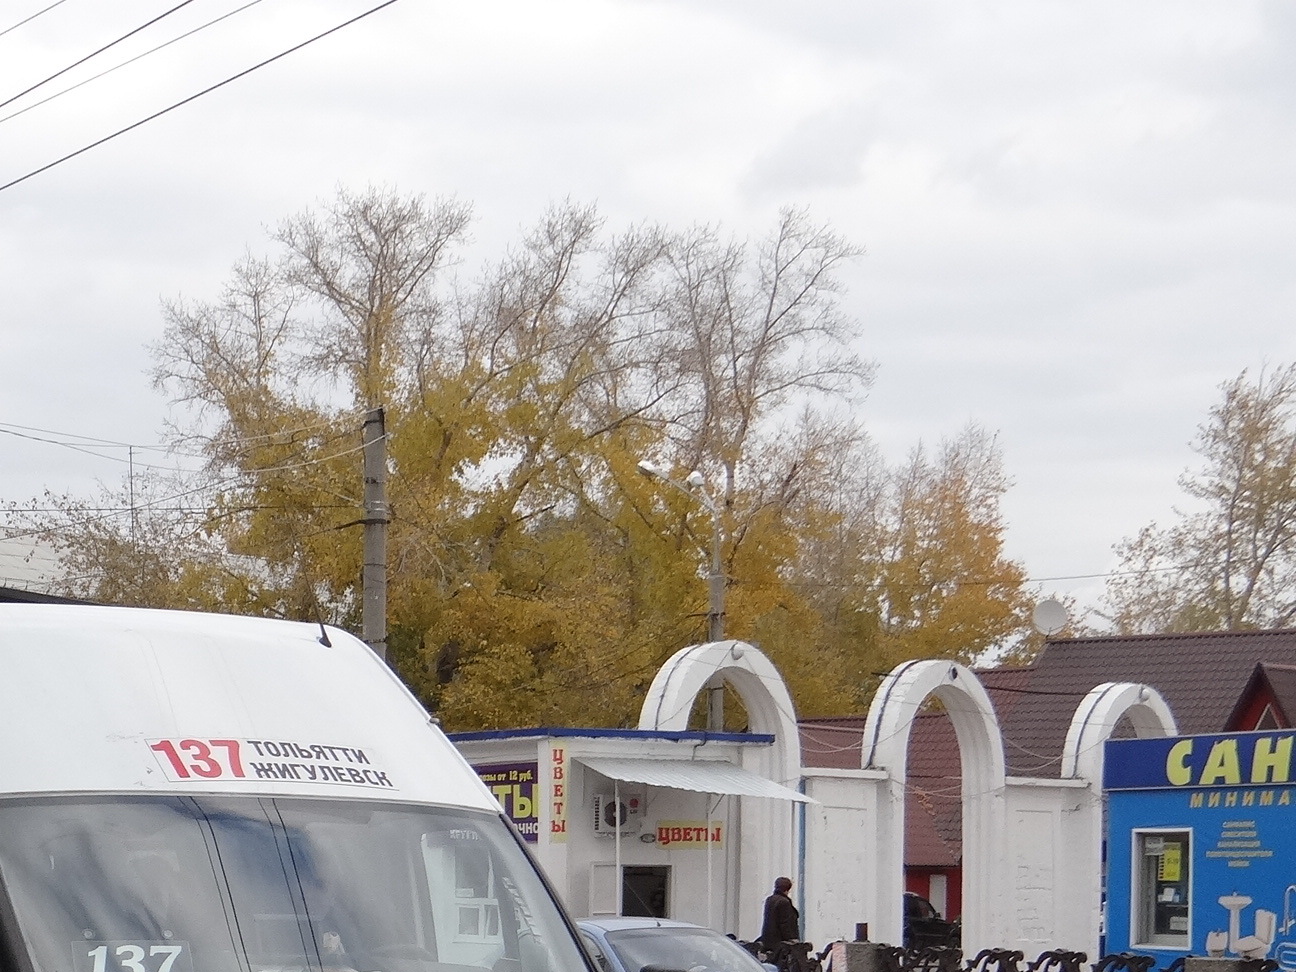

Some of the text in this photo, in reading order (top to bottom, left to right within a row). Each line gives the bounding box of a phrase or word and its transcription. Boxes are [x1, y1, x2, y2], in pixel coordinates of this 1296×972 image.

[150, 739, 372, 779] 137 ТОЛЬЯТТИ
[249, 761, 394, 788] ЖИГУЛЕВСК
[1166, 736, 1294, 786] САН
[497, 774, 507, 782] от
[509, 770, 518, 780] 12
[519, 769, 533, 782] руб.
[550, 748, 567, 833] ЦВЕТЫ
[492, 783, 539, 818] ТЫ
[1189, 790, 1290, 808] МИНИМА
[657, 827, 722, 845] ЦВЕТЫ
